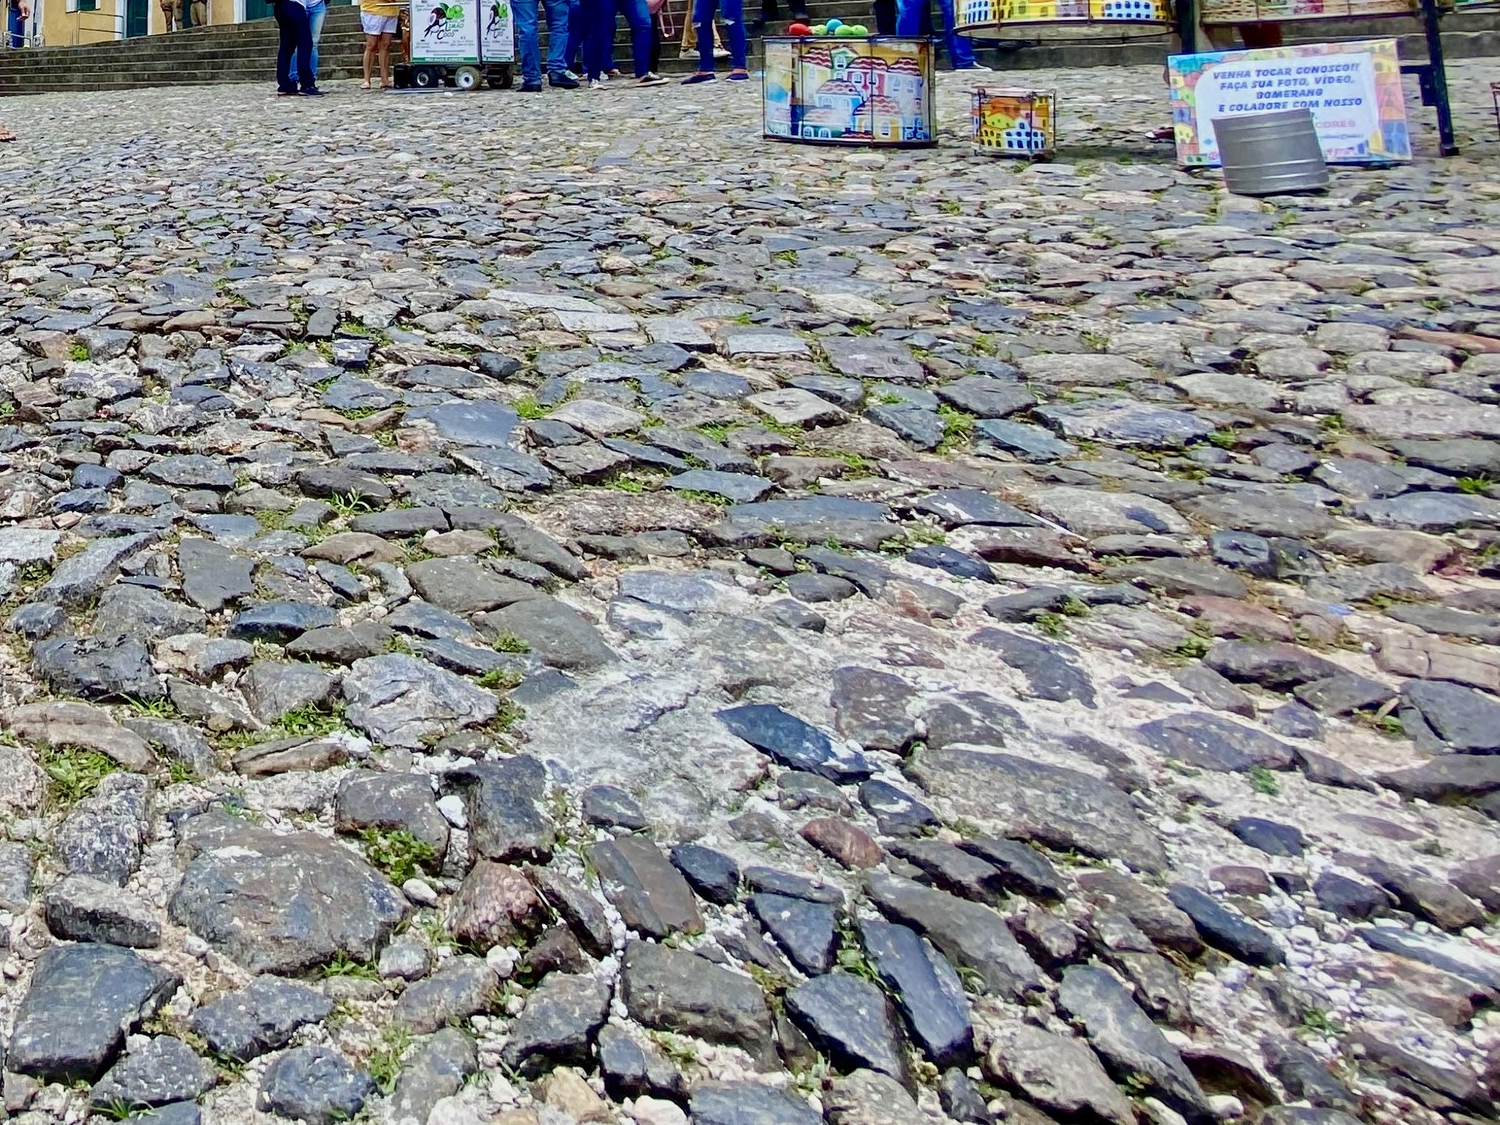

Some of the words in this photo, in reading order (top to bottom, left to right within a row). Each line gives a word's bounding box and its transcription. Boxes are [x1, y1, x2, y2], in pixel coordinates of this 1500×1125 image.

[1213, 70, 1251, 80] VENHA
[1255, 68, 1292, 78] TOCAR
[1296, 63, 1360, 75] CONOSCO!!
[1220, 81, 1248, 91] FAÇA
[1251, 80, 1273, 89] SUA
[1256, 89, 1323, 100] BOMERANG
[1218, 104, 1225, 113] E
[1229, 101, 1288, 112] COLABORE
[1292, 100, 1320, 109] COM
[1324, 98, 1363, 107] NOSSO
